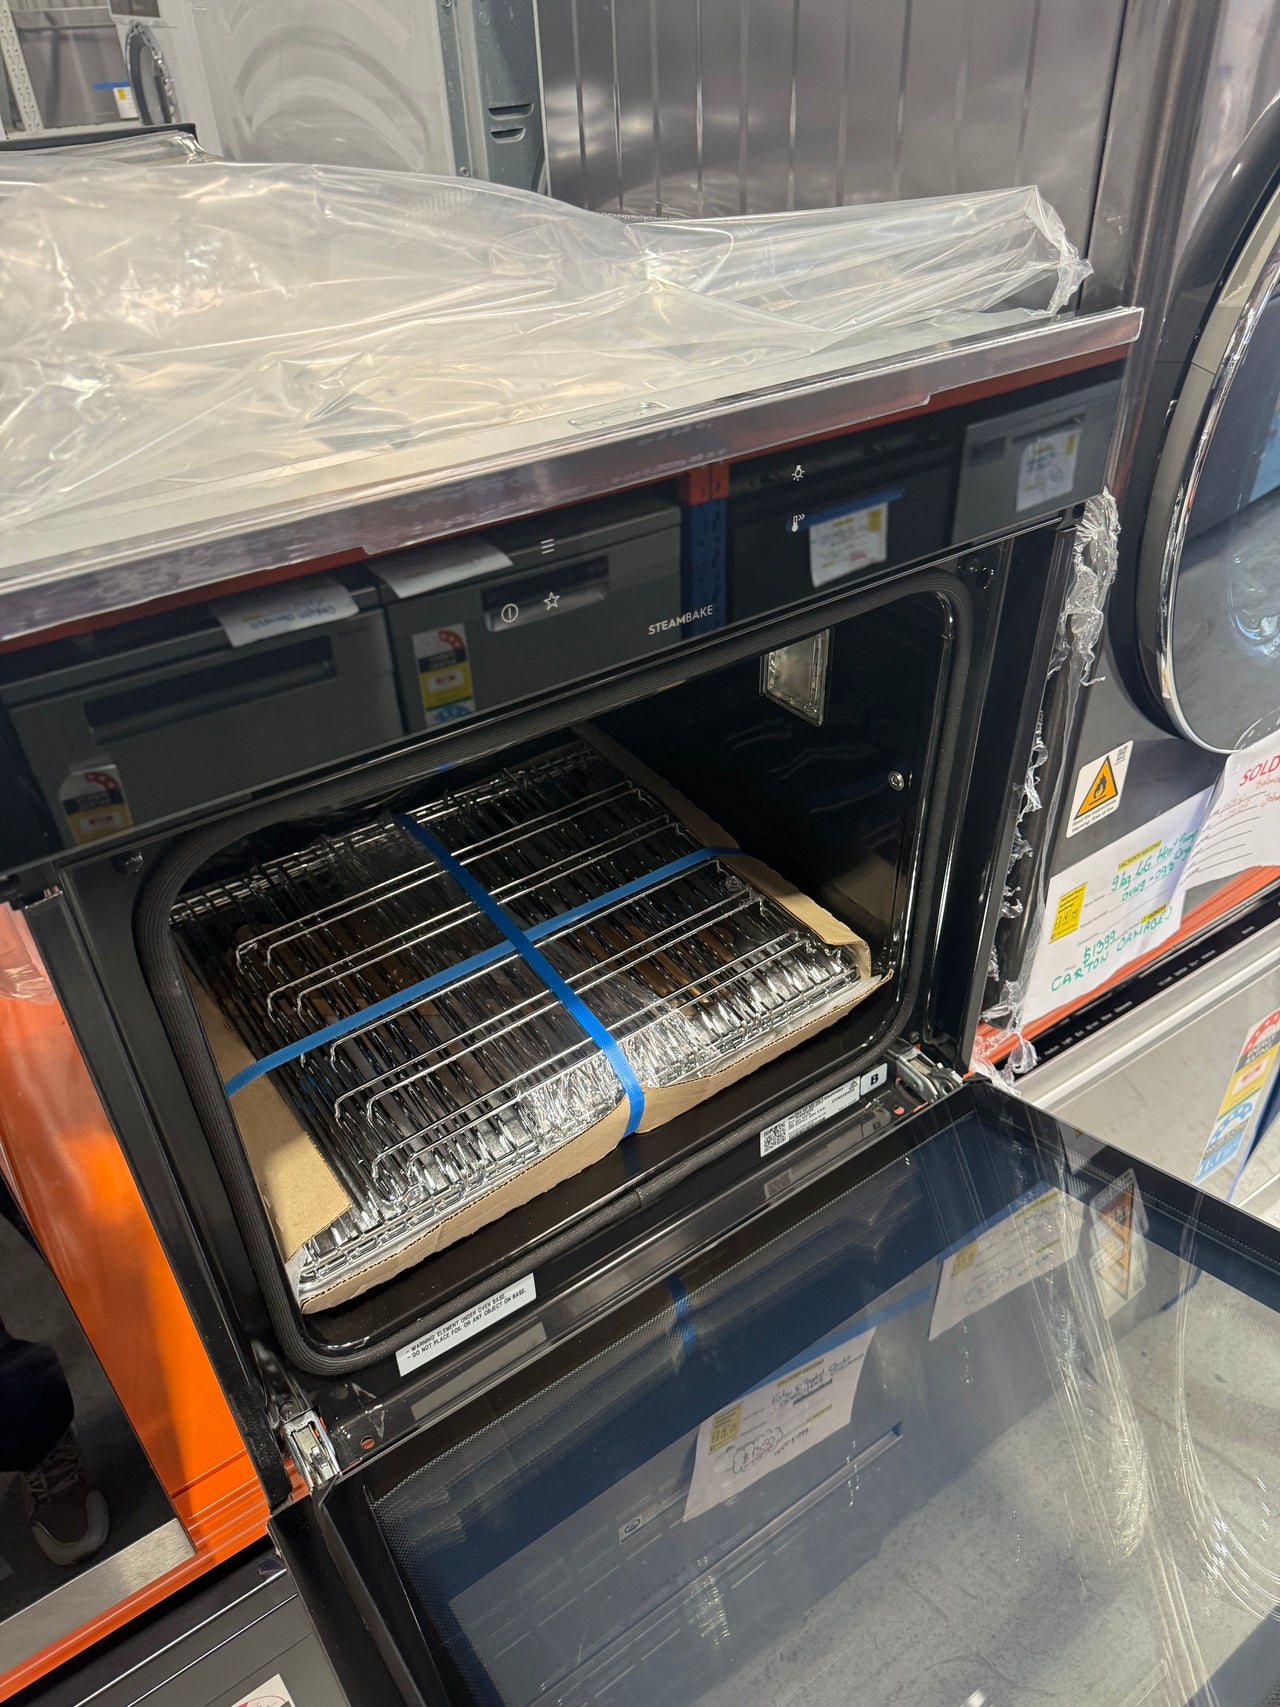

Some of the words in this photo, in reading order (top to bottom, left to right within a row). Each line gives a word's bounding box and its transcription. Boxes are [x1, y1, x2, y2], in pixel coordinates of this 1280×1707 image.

[648, 604, 714, 636] STEAMBAKE
[1239, 755, 1280, 787] SOLD
[1051, 951, 1109, 992] CARTON
[1116, 905, 1173, 952] DAMAGED
[1082, 930, 1116, 968] $1399
[870, 1073, 879, 1085] B
[411, 1335, 435, 1351] WARNING:
[437, 1320, 459, 1336] ELEMENT
[461, 1310, 477, 1324] UNDER
[478, 1301, 491, 1314] OVEN
[413, 1350, 420, 1358] DO
[421, 1343, 432, 1352] NOT
[434, 1333, 450, 1346] PLACE
[451, 1327, 462, 1336] FOIL
[464, 1320, 471, 1328] OR
[472, 1314, 483, 1324] ANY
[484, 1303, 503, 1317] OBJECT
[504, 1296, 512, 1305] ON
